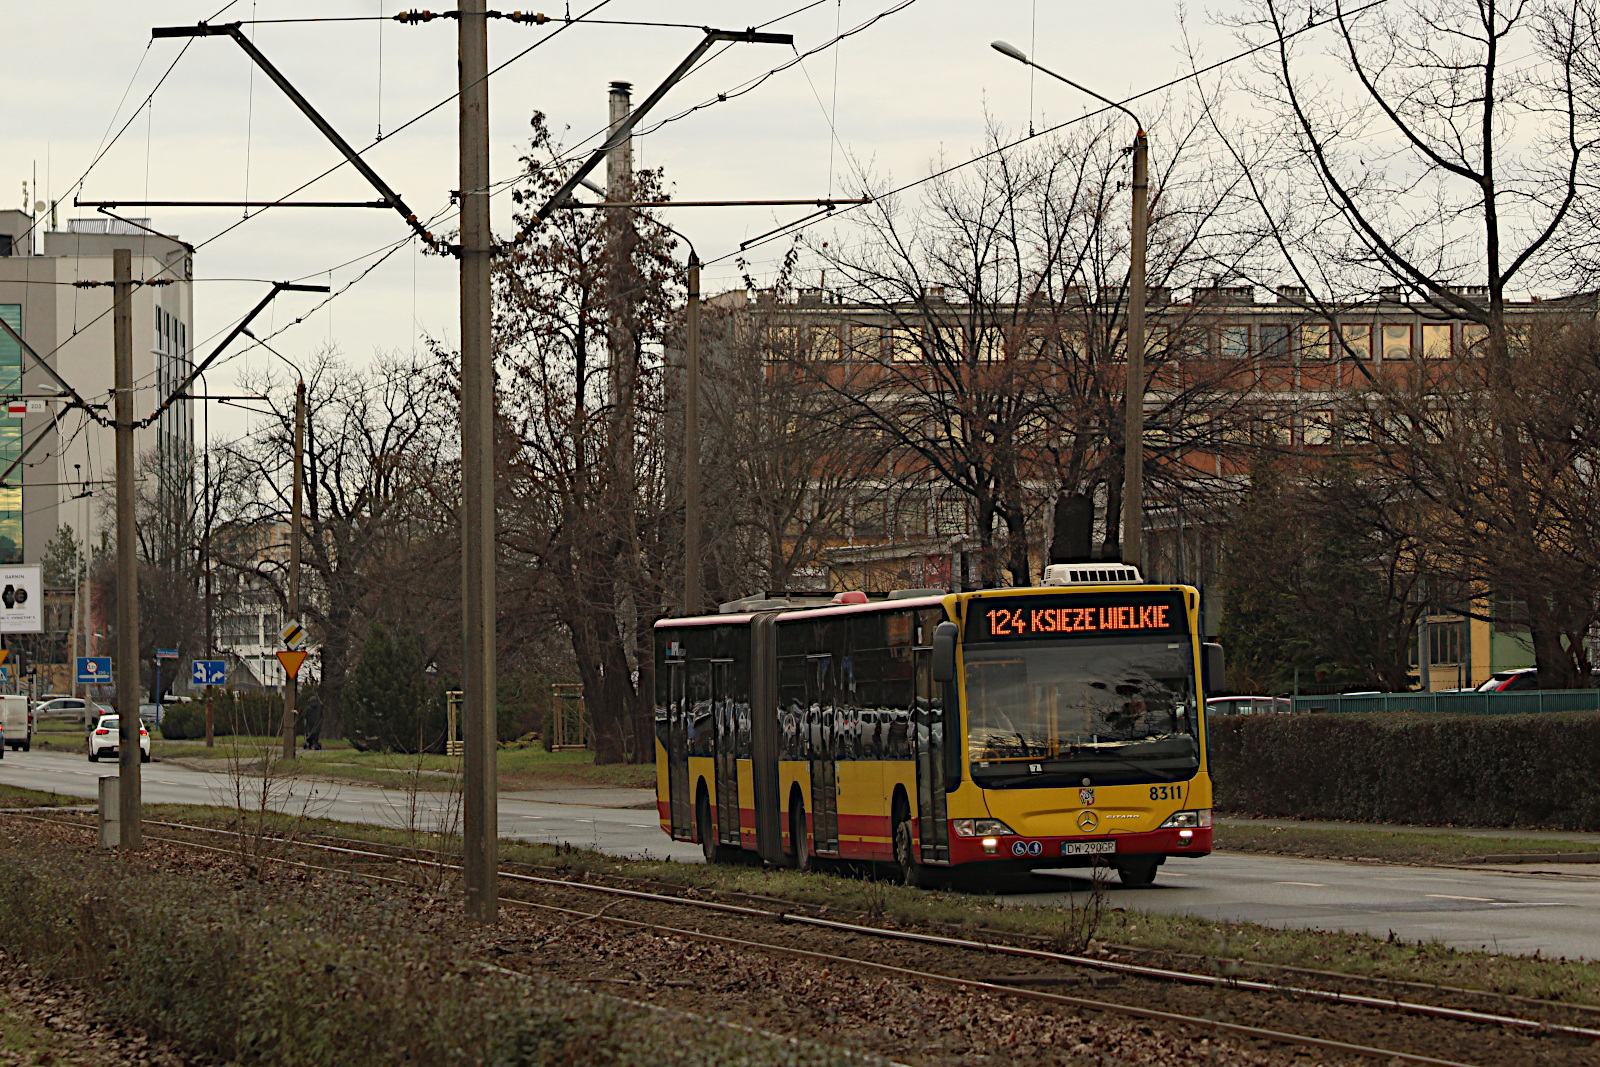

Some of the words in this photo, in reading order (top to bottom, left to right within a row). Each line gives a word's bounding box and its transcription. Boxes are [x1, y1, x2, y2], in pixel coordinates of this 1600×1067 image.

[986, 608, 1027, 635] 124
[1099, 605, 1170, 630] WIELKIE
[1149, 785, 1182, 801] 8311
[1067, 843, 1081, 854] DW
